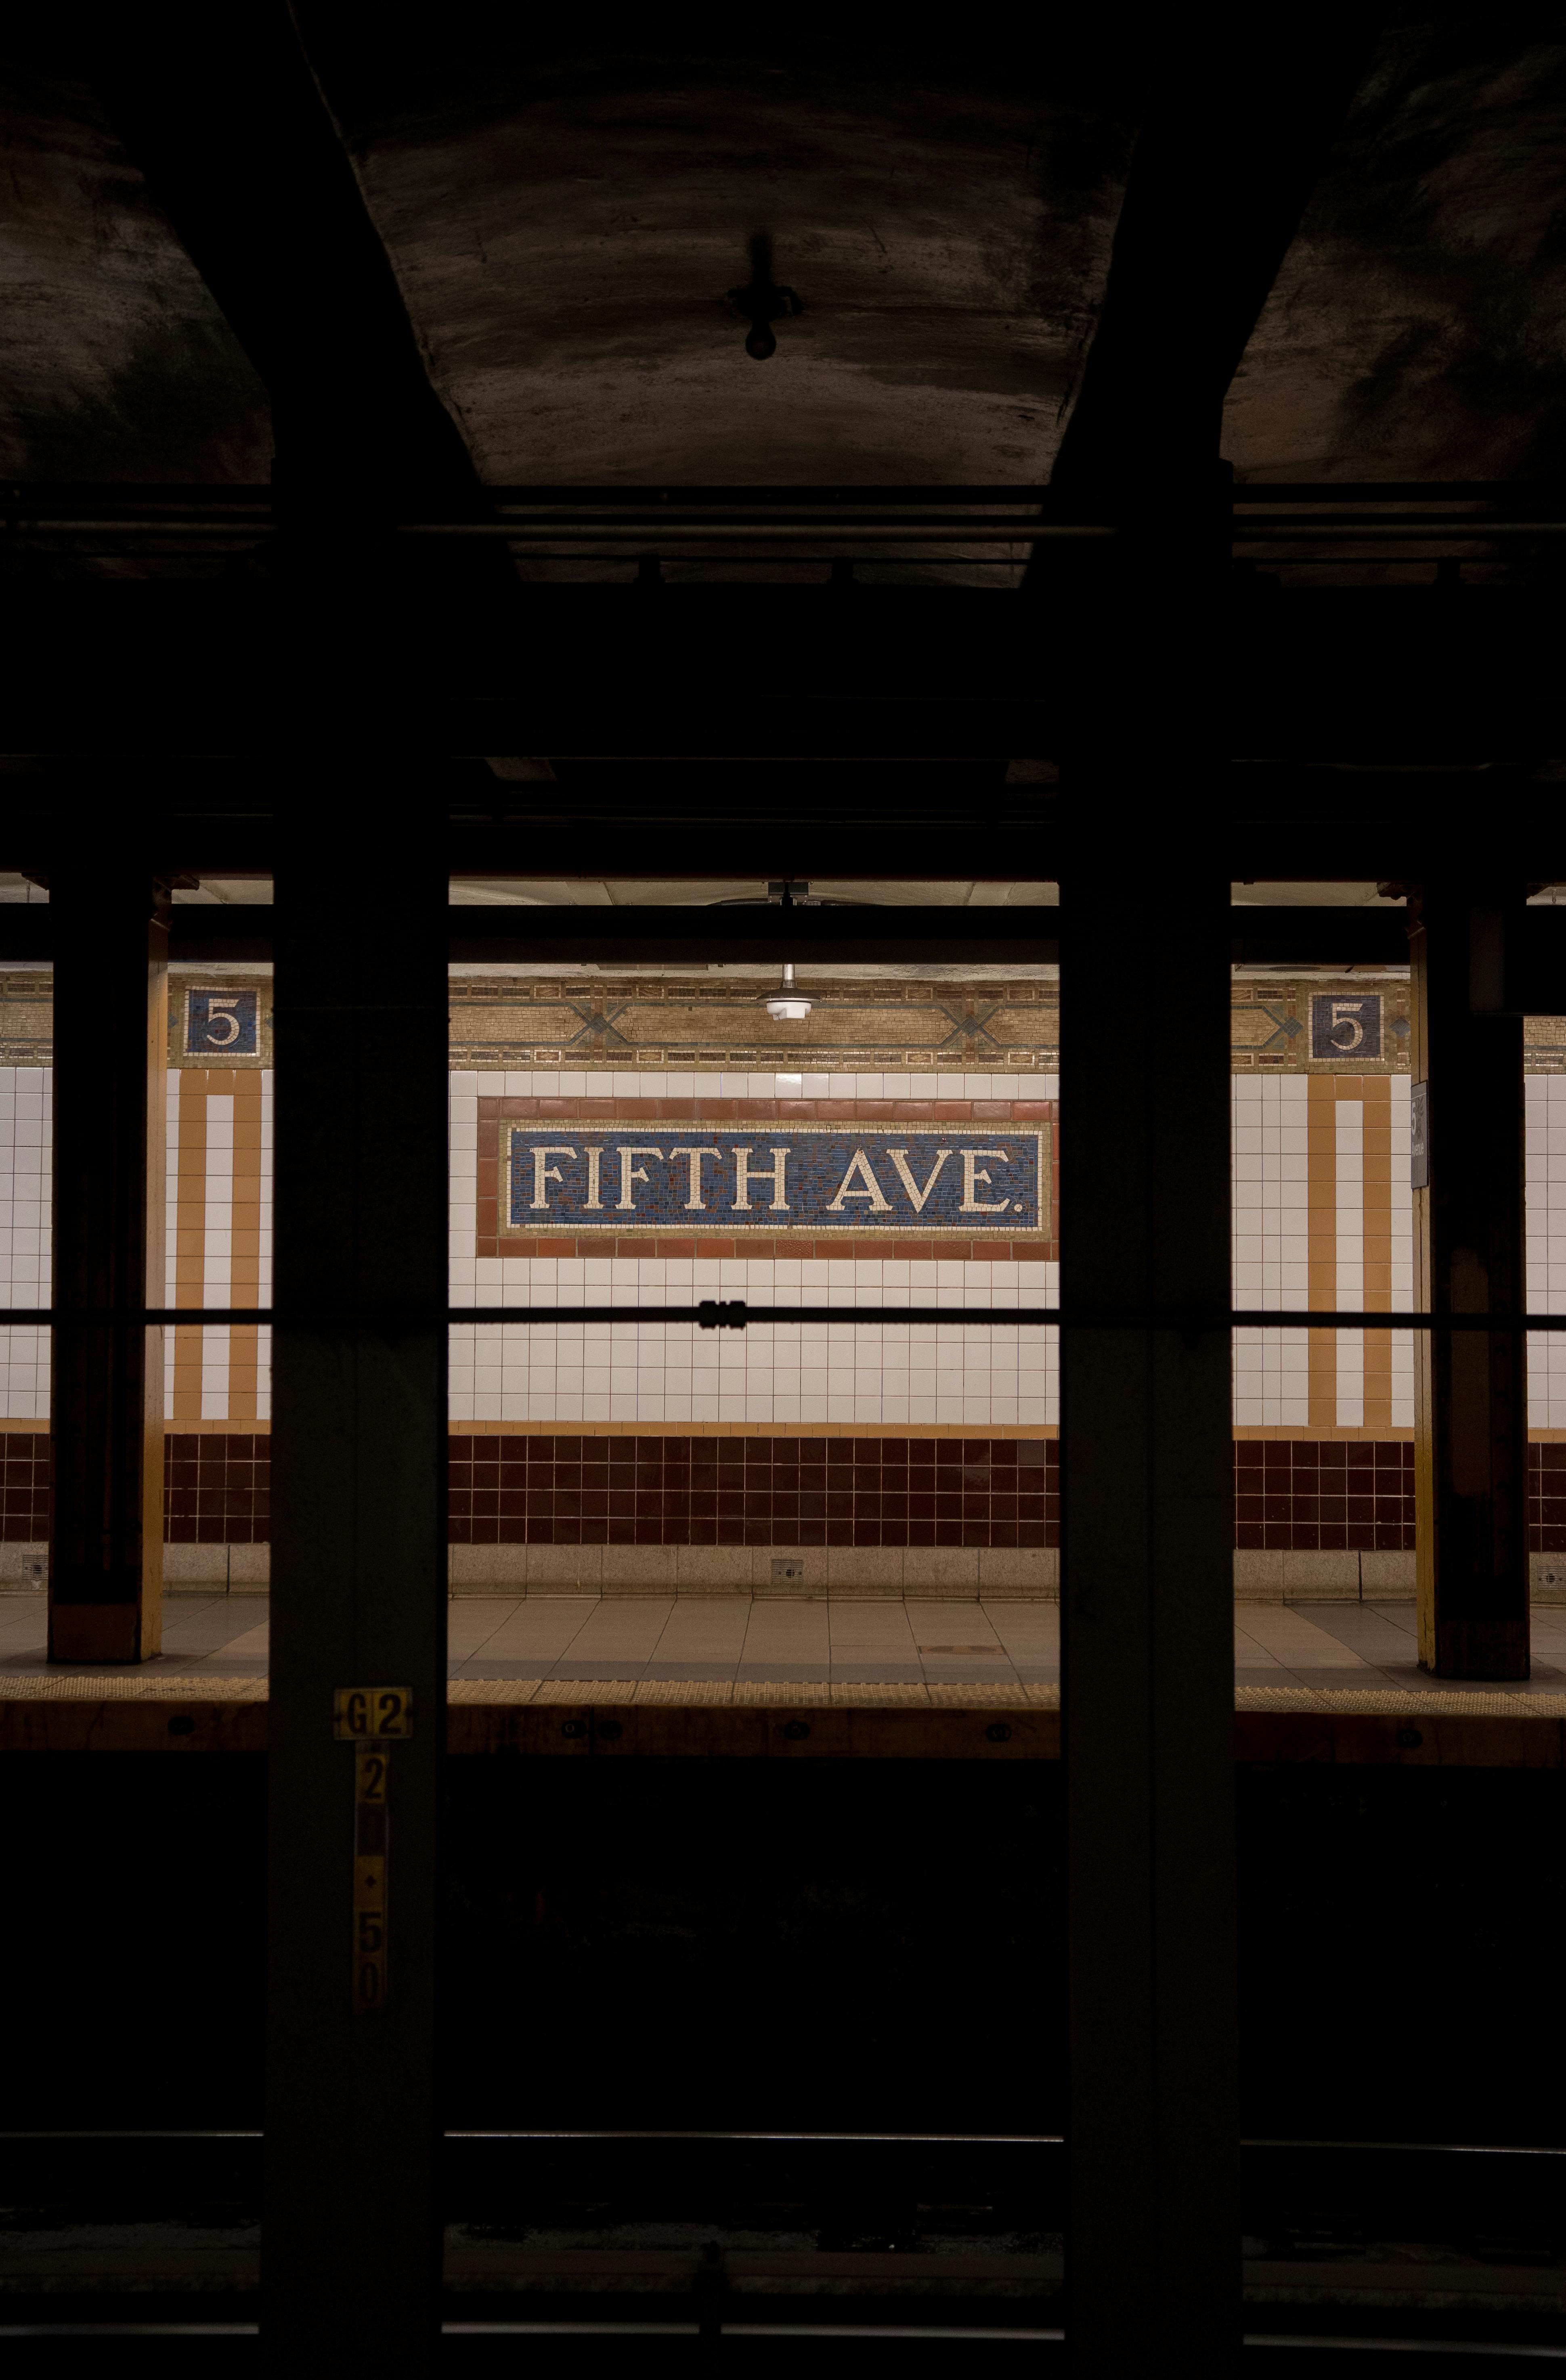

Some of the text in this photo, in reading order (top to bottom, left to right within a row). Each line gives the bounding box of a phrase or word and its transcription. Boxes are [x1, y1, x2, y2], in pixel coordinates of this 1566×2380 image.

[207, 998, 239, 1045] 5
[1330, 1003, 1363, 1050] 5
[1411, 1102, 1416, 1135] 5
[530, 1147, 1023, 1213] FIFTH AVE.
[348, 1693, 401, 1734] G2
